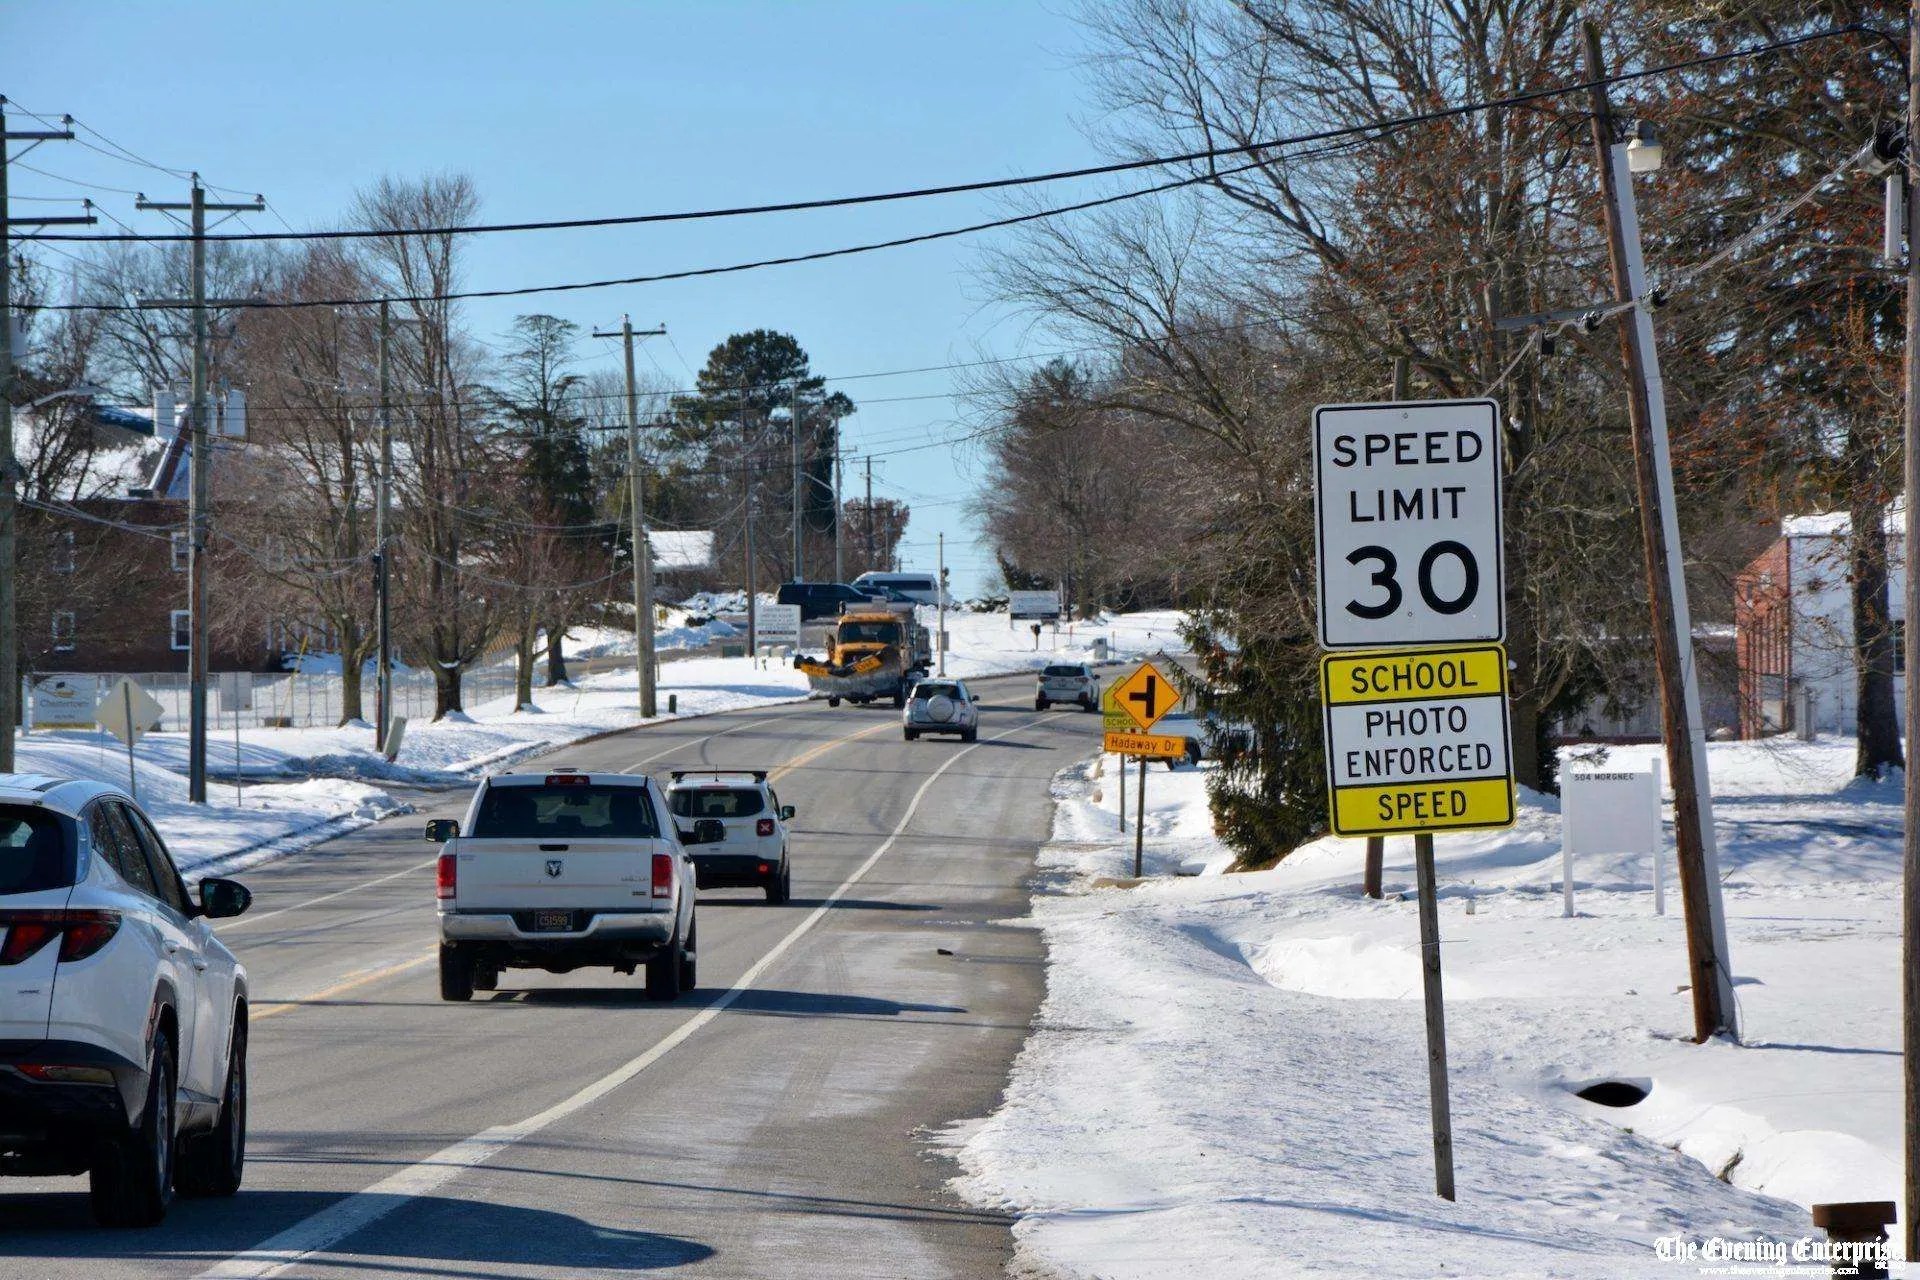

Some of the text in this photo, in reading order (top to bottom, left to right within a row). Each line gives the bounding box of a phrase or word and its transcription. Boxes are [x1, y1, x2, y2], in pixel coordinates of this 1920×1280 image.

[1332, 431, 1482, 467] SPEED
[1351, 487, 1466, 522] LIMIT
[1345, 540, 1479, 619] 30
[1351, 660, 1478, 694] SCHOOL
[1366, 705, 1468, 738] PHOTO
[1111, 737, 1176, 752] Hadaway Dr
[1346, 743, 1492, 778] ENFORCED
[1378, 790, 1467, 821] SPEED
